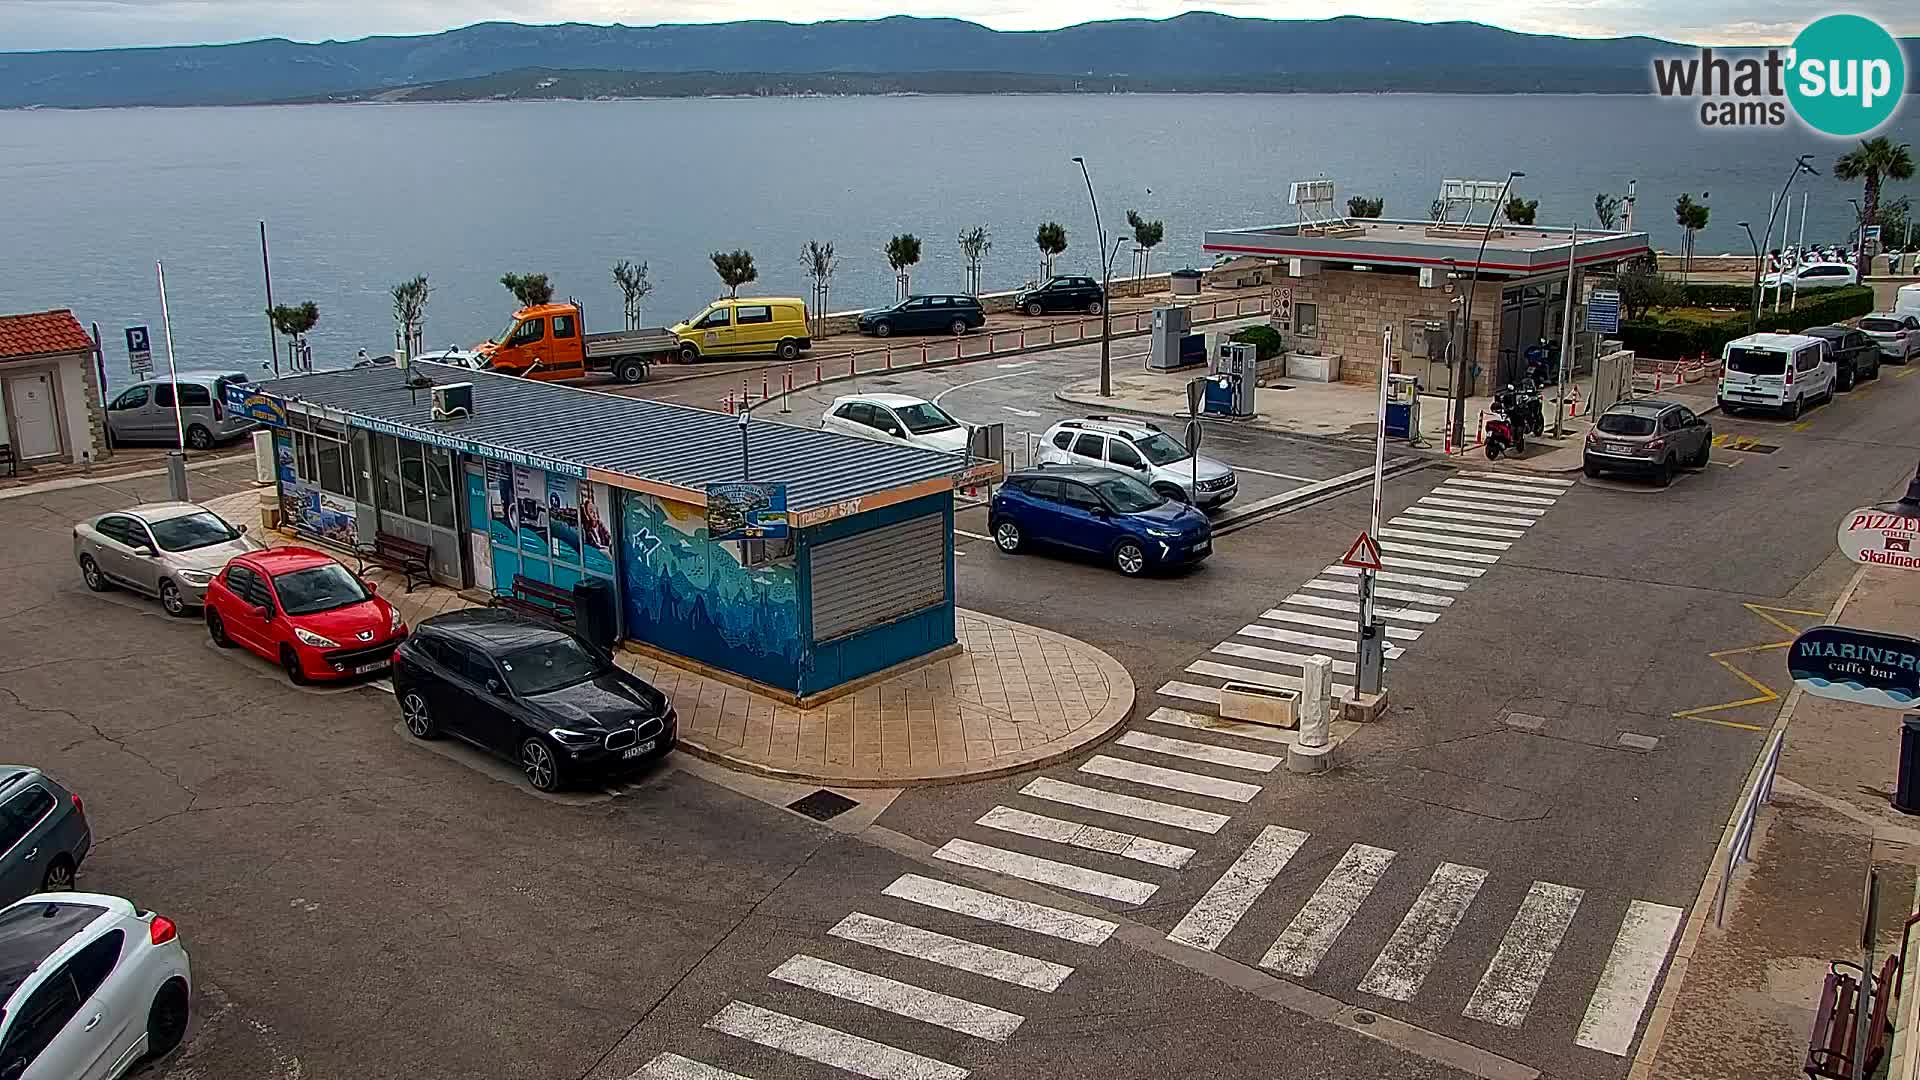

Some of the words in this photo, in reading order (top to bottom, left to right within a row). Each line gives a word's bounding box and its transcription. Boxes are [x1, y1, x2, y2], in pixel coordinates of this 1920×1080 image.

[396, 427, 437, 444] AUTOBUSNA
[437, 437, 469, 452] POSTAJA
[479, 445, 494, 457] BUS
[494, 449, 527, 465] STATION
[528, 456, 555, 471] TICKET
[556, 461, 583, 476] OFFICE
[1848, 514, 1920, 533] PIZZE
[1828, 662, 1866, 675] caffe
[1870, 665, 1897, 679] bar
